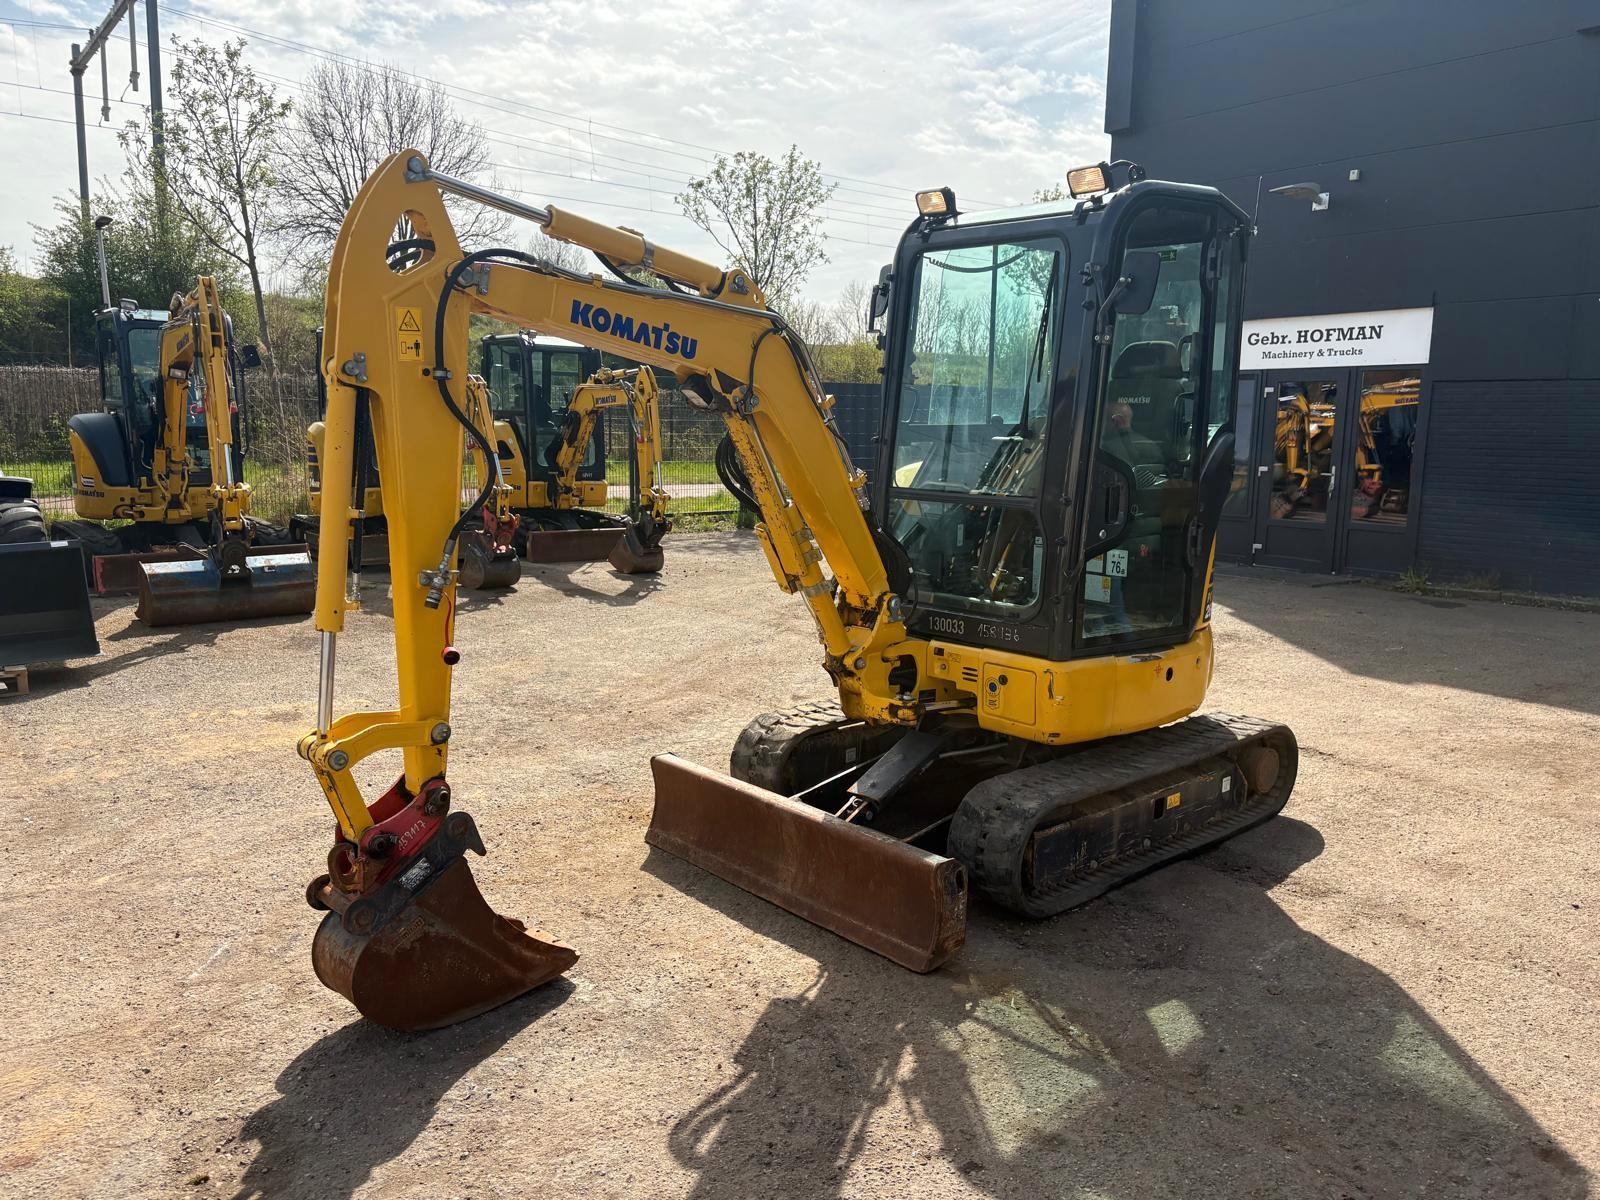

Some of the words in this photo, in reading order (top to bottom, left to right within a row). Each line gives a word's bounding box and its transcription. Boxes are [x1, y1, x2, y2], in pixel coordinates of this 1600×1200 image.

[570, 299, 698, 360] KOMATSU
[1247, 332, 1292, 346] Gebr.
[1296, 325, 1384, 344] HOFMAN
[1261, 350, 1315, 360] Machinery
[1316, 349, 1326, 357] &
[1326, 347, 1363, 357] Trucks
[1111, 560, 1121, 574] 76
[928, 616, 965, 635] 130033
